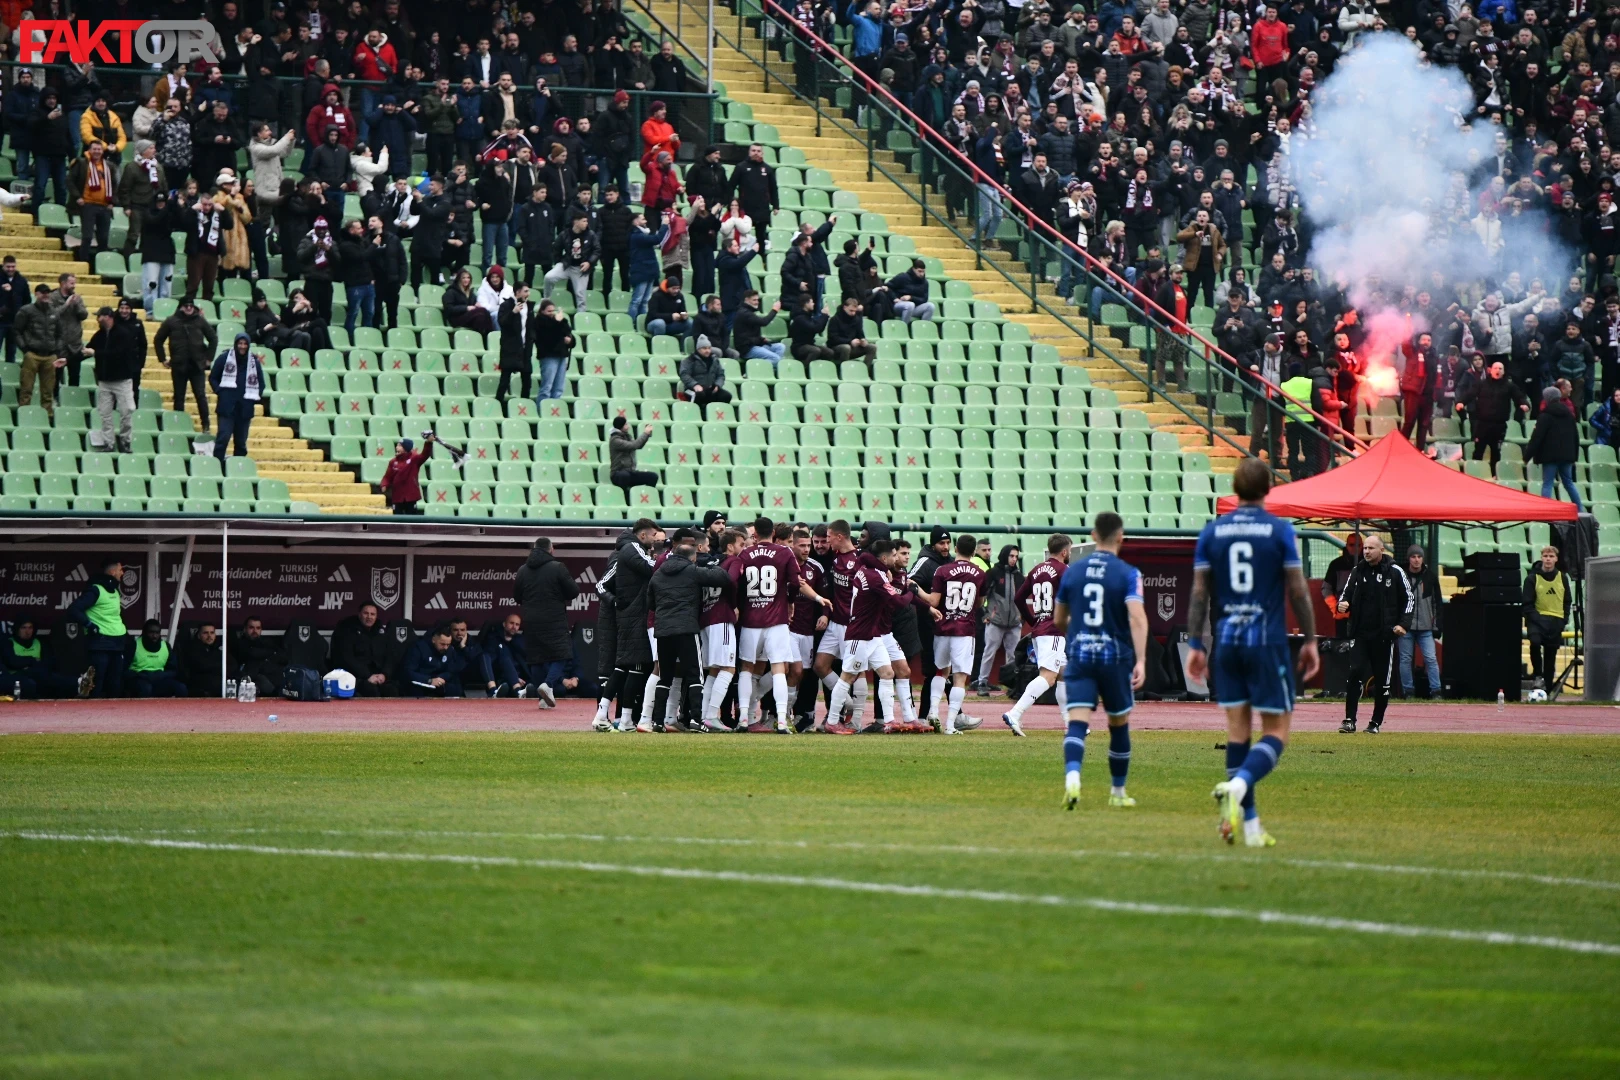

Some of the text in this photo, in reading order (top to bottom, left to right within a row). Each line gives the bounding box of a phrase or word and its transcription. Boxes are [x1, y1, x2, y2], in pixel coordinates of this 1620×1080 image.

[14, 562, 55, 571] TURKISH
[279, 564, 318, 573] TURKISH
[949, 565, 980, 577] CIMIROT
[1229, 541, 1254, 594] 6
[13, 573, 55, 582] AIRLINES
[278, 574, 318, 583] AIRLINES
[745, 565, 777, 597] 28
[0, 593, 48, 605] idianbet
[203, 590, 242, 599] TURISH
[456, 591, 493, 599] TURKISH
[945, 580, 977, 613] 59
[1032, 581, 1054, 613] 33
[202, 600, 242, 609] AIRLNES
[248, 594, 312, 606] meridianbet
[1083, 582, 1105, 627] 3
[455, 601, 493, 610] AIRLINES
